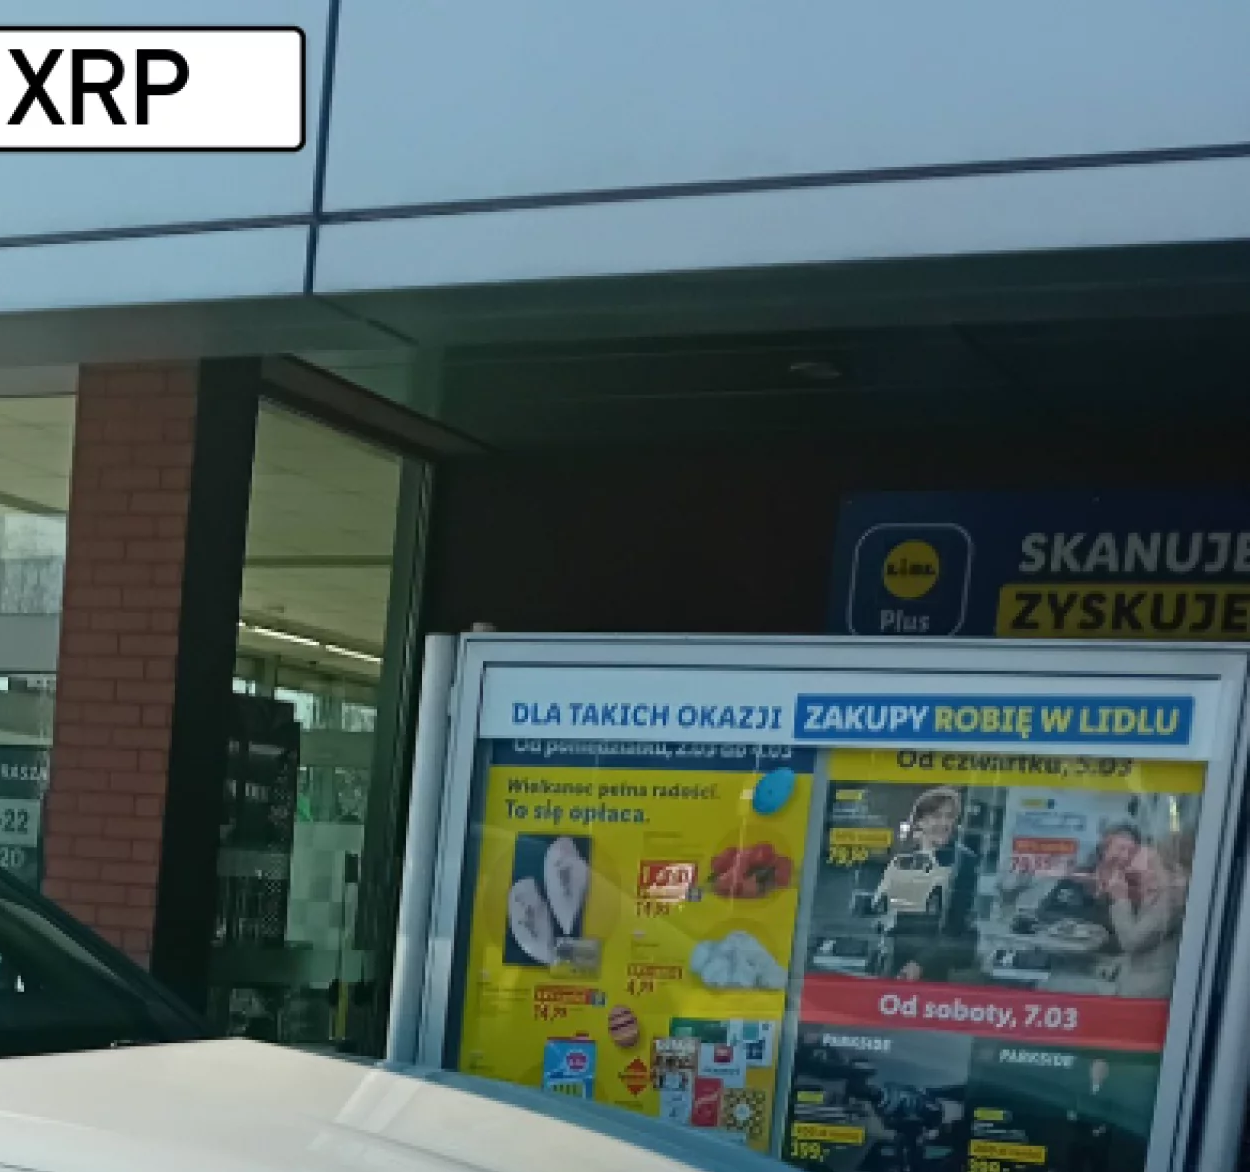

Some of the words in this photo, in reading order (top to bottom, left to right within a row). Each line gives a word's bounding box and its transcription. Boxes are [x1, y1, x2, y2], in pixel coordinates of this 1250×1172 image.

[880, 609, 931, 633] Plus
[1011, 592, 1250, 632] ZYSKUJE
[511, 702, 561, 725] DLA
[569, 702, 669, 727] TAKICH
[677, 704, 782, 730] OKAZJI
[803, 704, 930, 733] ZAKUPY
[934, 705, 1034, 739] ROBIĘ
[1041, 706, 1073, 734] W
[1079, 707, 1180, 736] LIDLU
[896, 750, 933, 768] Od
[504, 799, 529, 819] To
[878, 994, 918, 1019] Od
[923, 999, 1017, 1029] soboty,
[1024, 1004, 1079, 1031] 7.03
